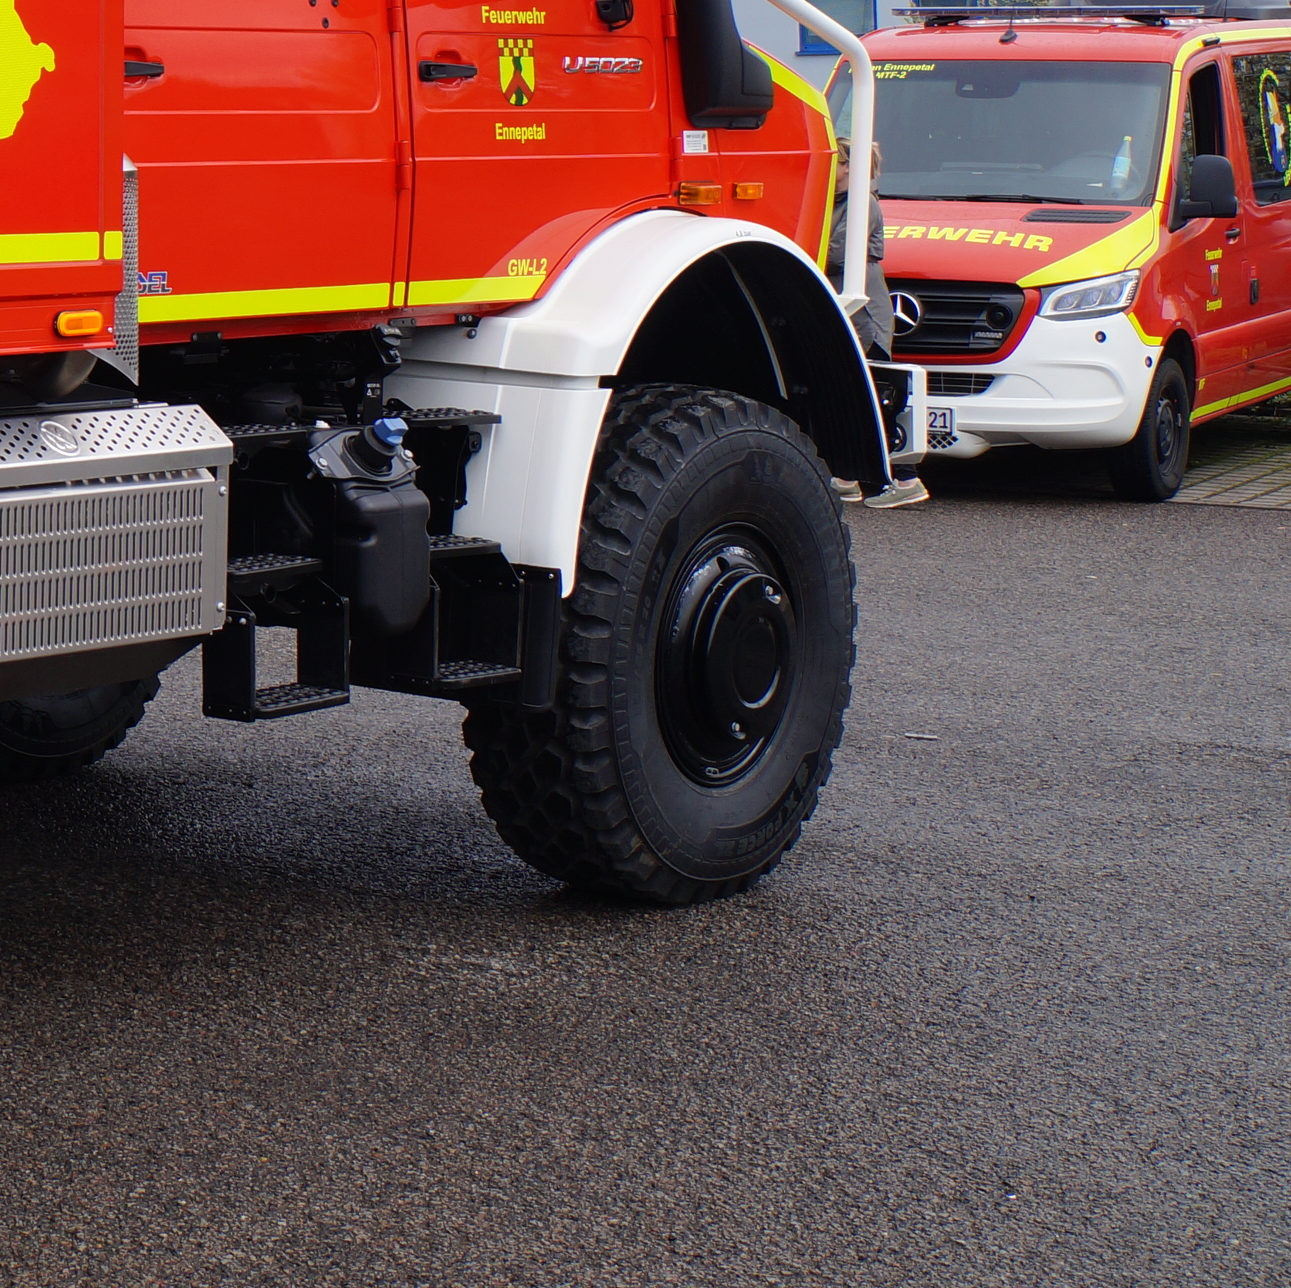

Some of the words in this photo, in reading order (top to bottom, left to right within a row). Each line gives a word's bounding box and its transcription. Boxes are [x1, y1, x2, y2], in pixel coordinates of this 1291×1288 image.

[481, 5, 546, 25] Feuerwehr
[495, 122, 546, 144] Ennepetal
[883, 226, 1054, 252] ERWEHR
[508, 257, 548, 276] GW-L2
